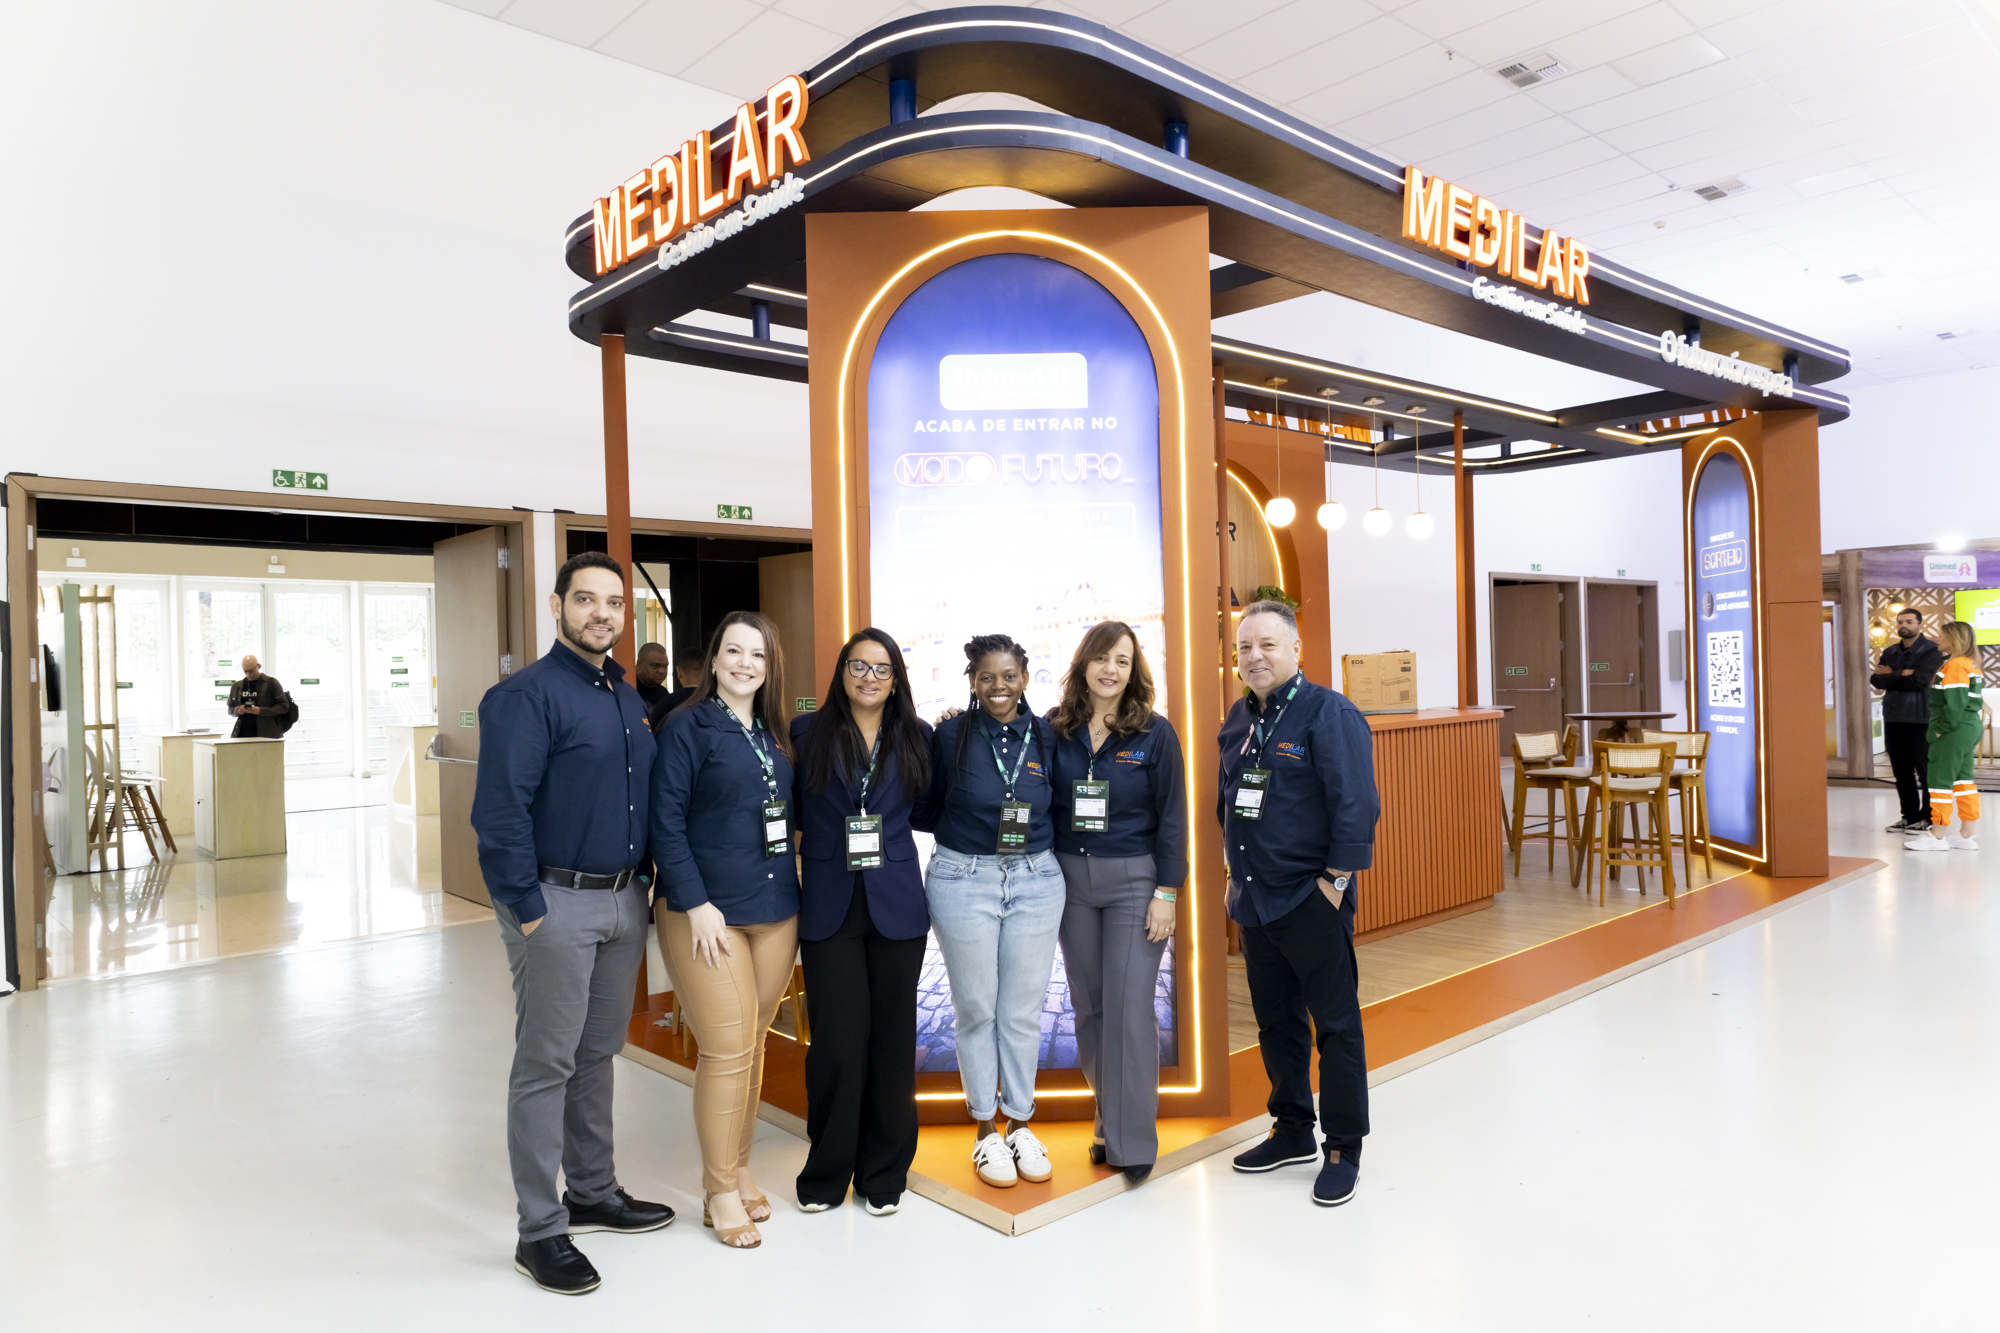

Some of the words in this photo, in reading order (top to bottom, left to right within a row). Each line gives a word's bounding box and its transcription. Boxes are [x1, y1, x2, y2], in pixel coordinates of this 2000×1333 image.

[593, 74, 811, 276] MEDILAR
[714, 210, 744, 241] em
[742, 172, 805, 226] Saúde
[1402, 165, 1589, 306] MEDILAR
[914, 419, 976, 433] ACABA
[983, 419, 1006, 432] DE
[1013, 417, 1085, 432] ENTRAR
[1091, 416, 1118, 430] NO
[1704, 547, 1742, 570] SORTEIO
[1929, 561, 1957, 570] Unimed
[1116, 750, 1145, 758] MEDILAR
[1277, 742, 1305, 754] MEDILAR
[1076, 785, 1088, 794] 53
[849, 821, 861, 831] 53
